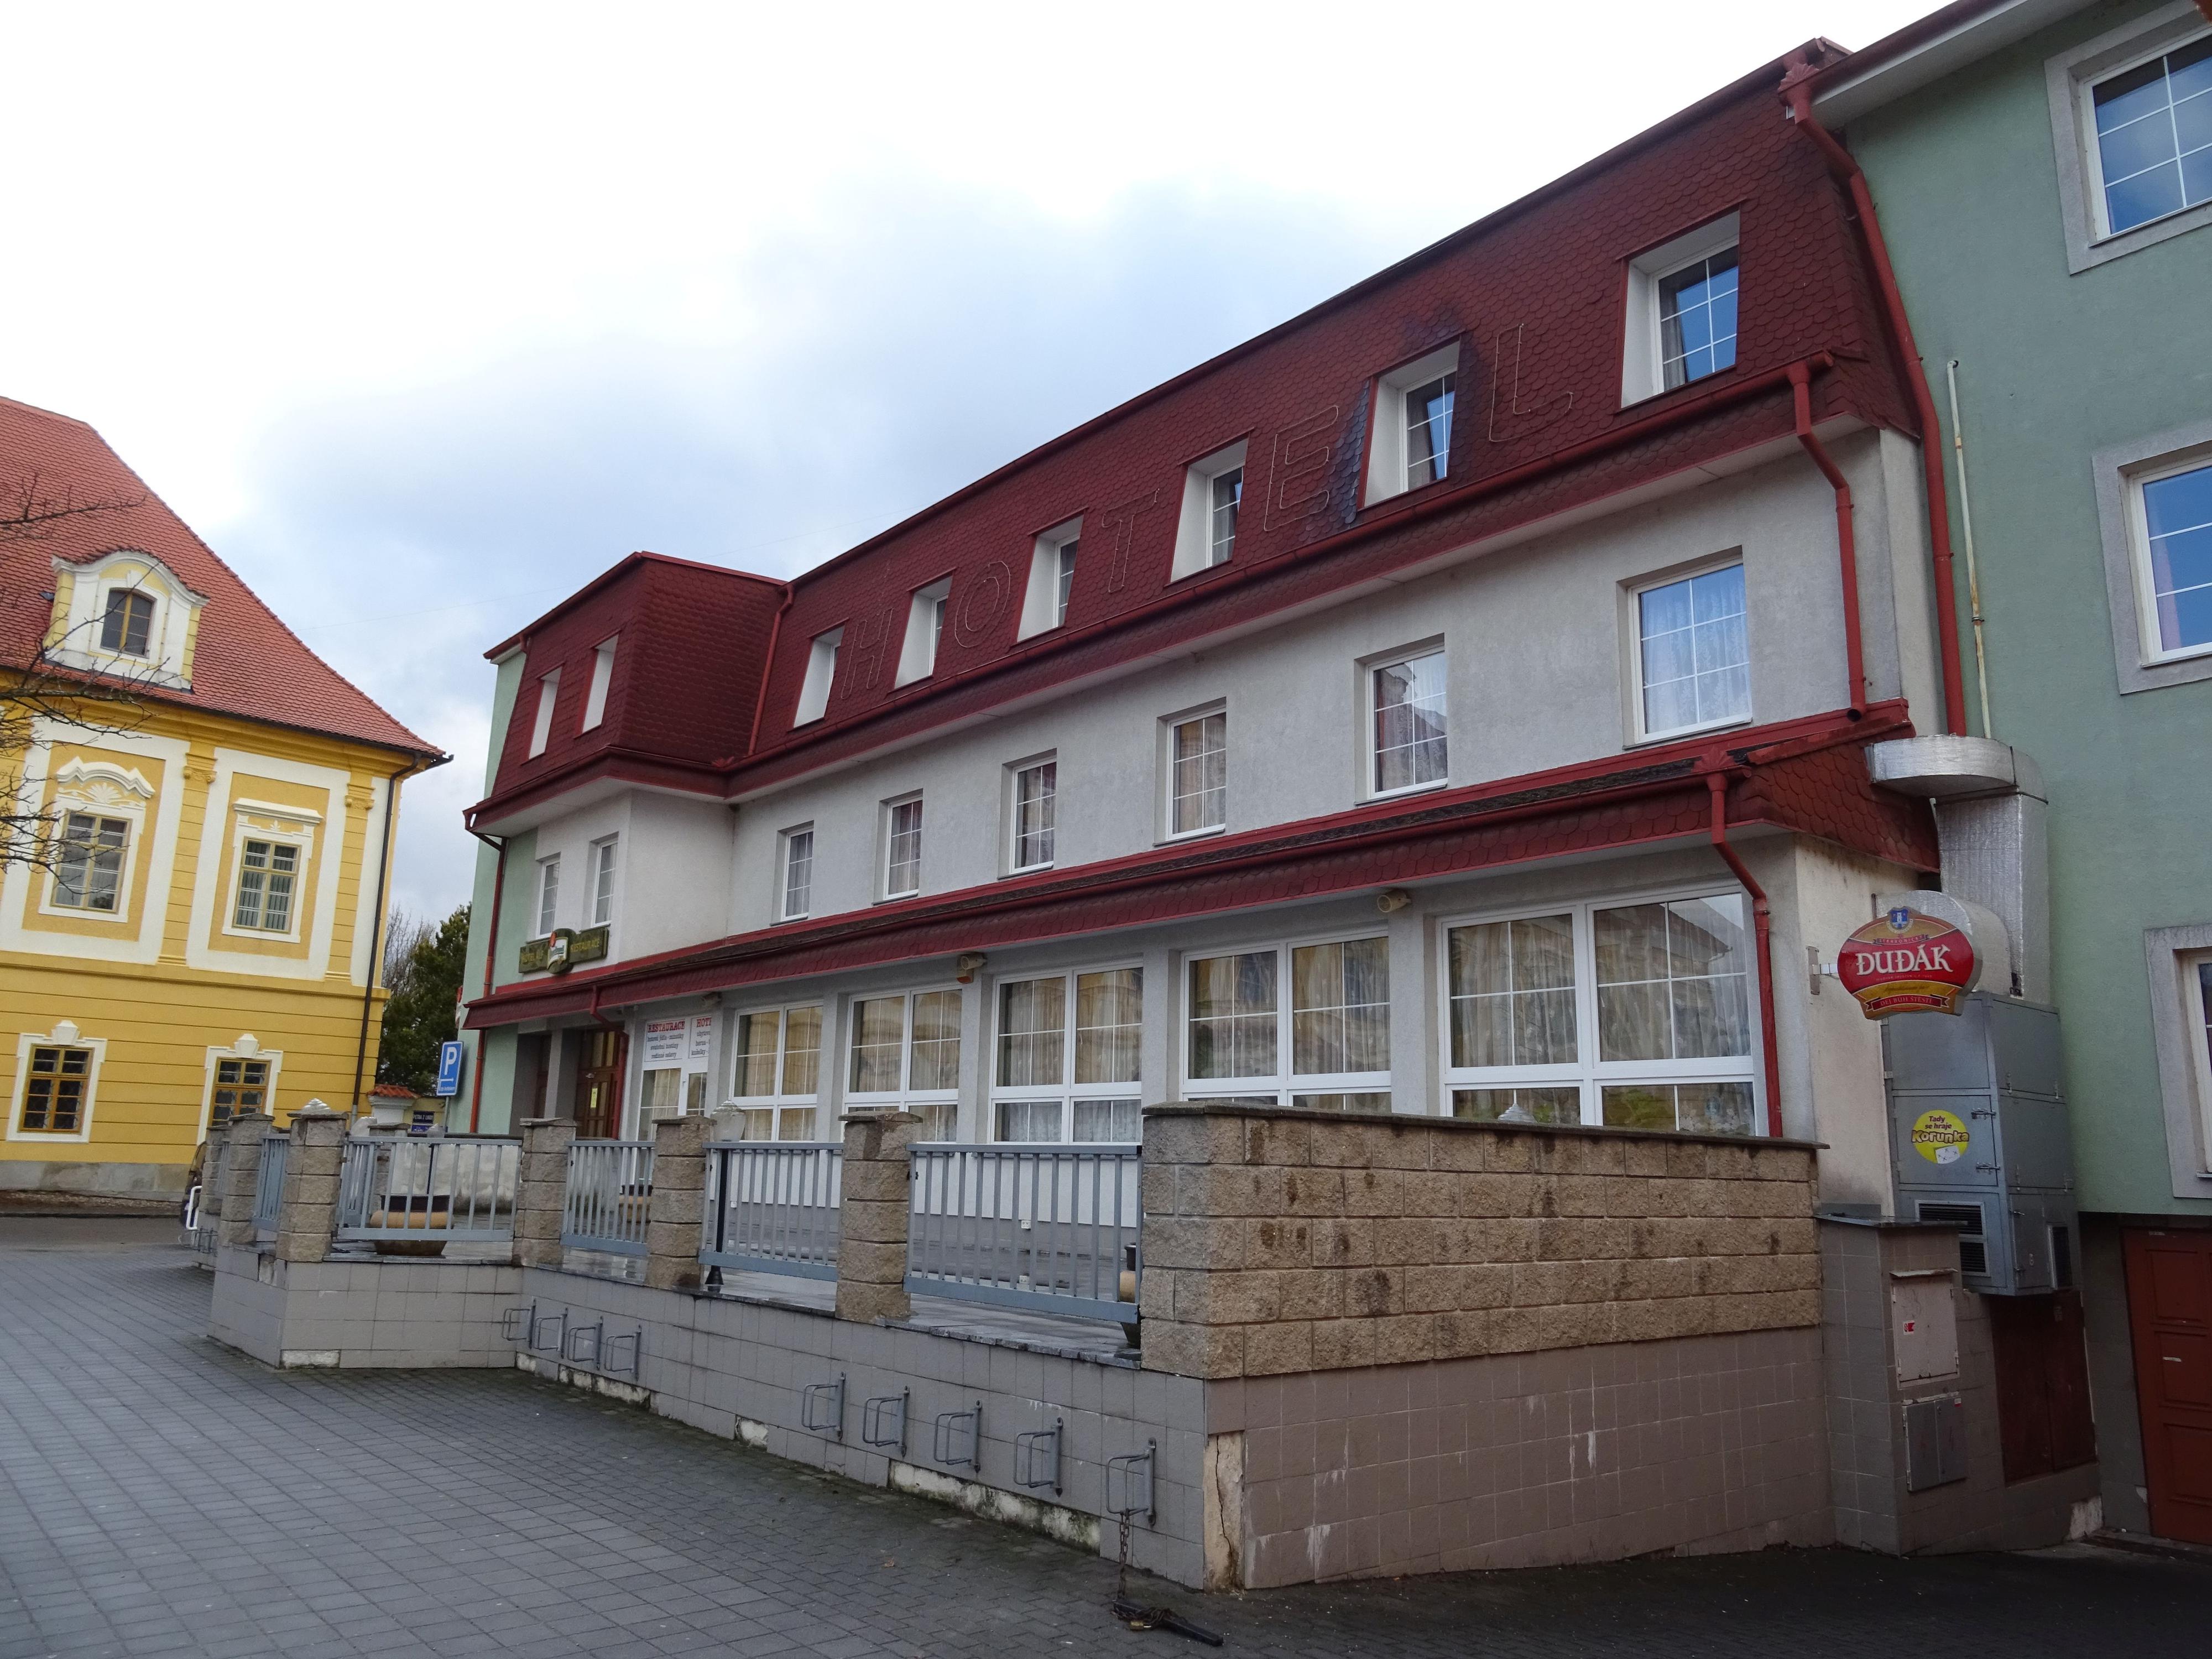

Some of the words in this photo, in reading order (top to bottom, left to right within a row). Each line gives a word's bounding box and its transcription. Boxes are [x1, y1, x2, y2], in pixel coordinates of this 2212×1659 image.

[841, 323, 1574, 700] HOTEL
[648, 1021, 685, 1033] RESTAURACE
[445, 1047, 457, 1075] P
[1911, 1130, 1970, 1144] Korunka
